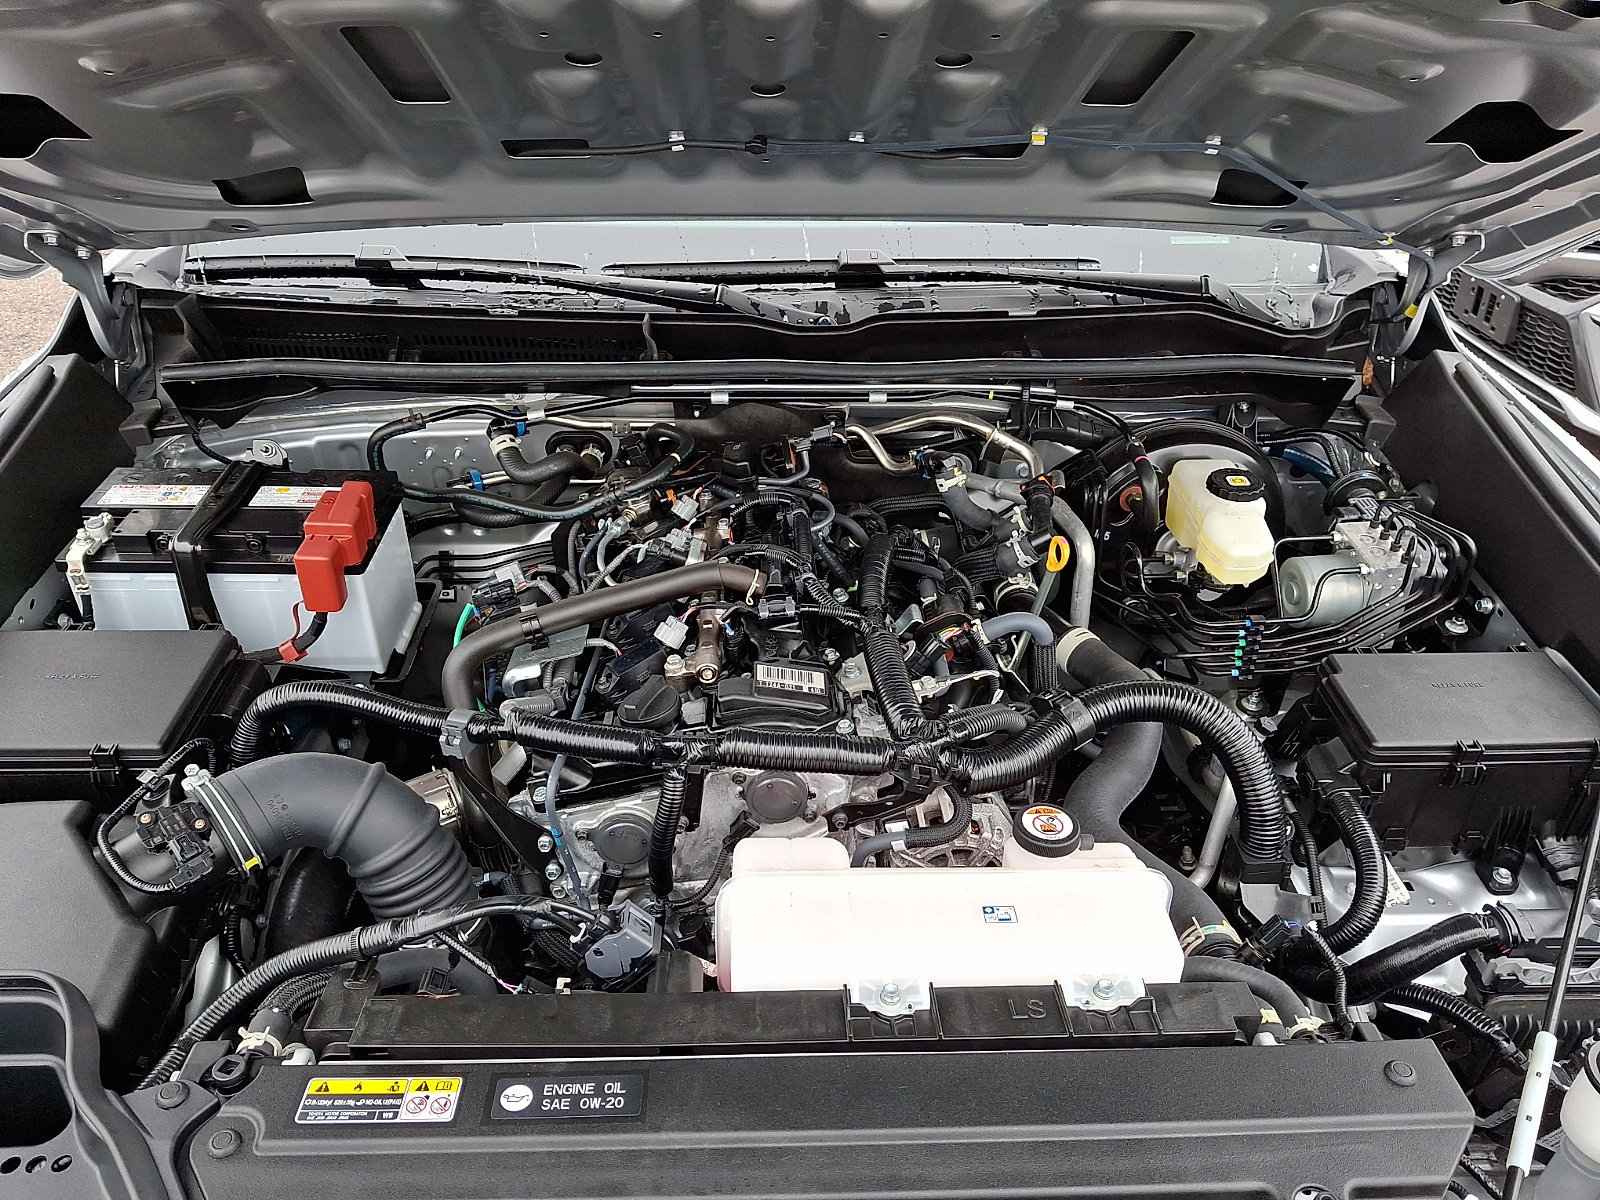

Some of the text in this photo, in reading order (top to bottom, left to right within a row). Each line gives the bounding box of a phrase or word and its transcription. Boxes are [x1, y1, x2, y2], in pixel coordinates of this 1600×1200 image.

[1007, 998, 1047, 1019] LS
[543, 1082, 627, 1096] ENGINE OIL
[540, 1096, 625, 1111] SAE 0W-20
